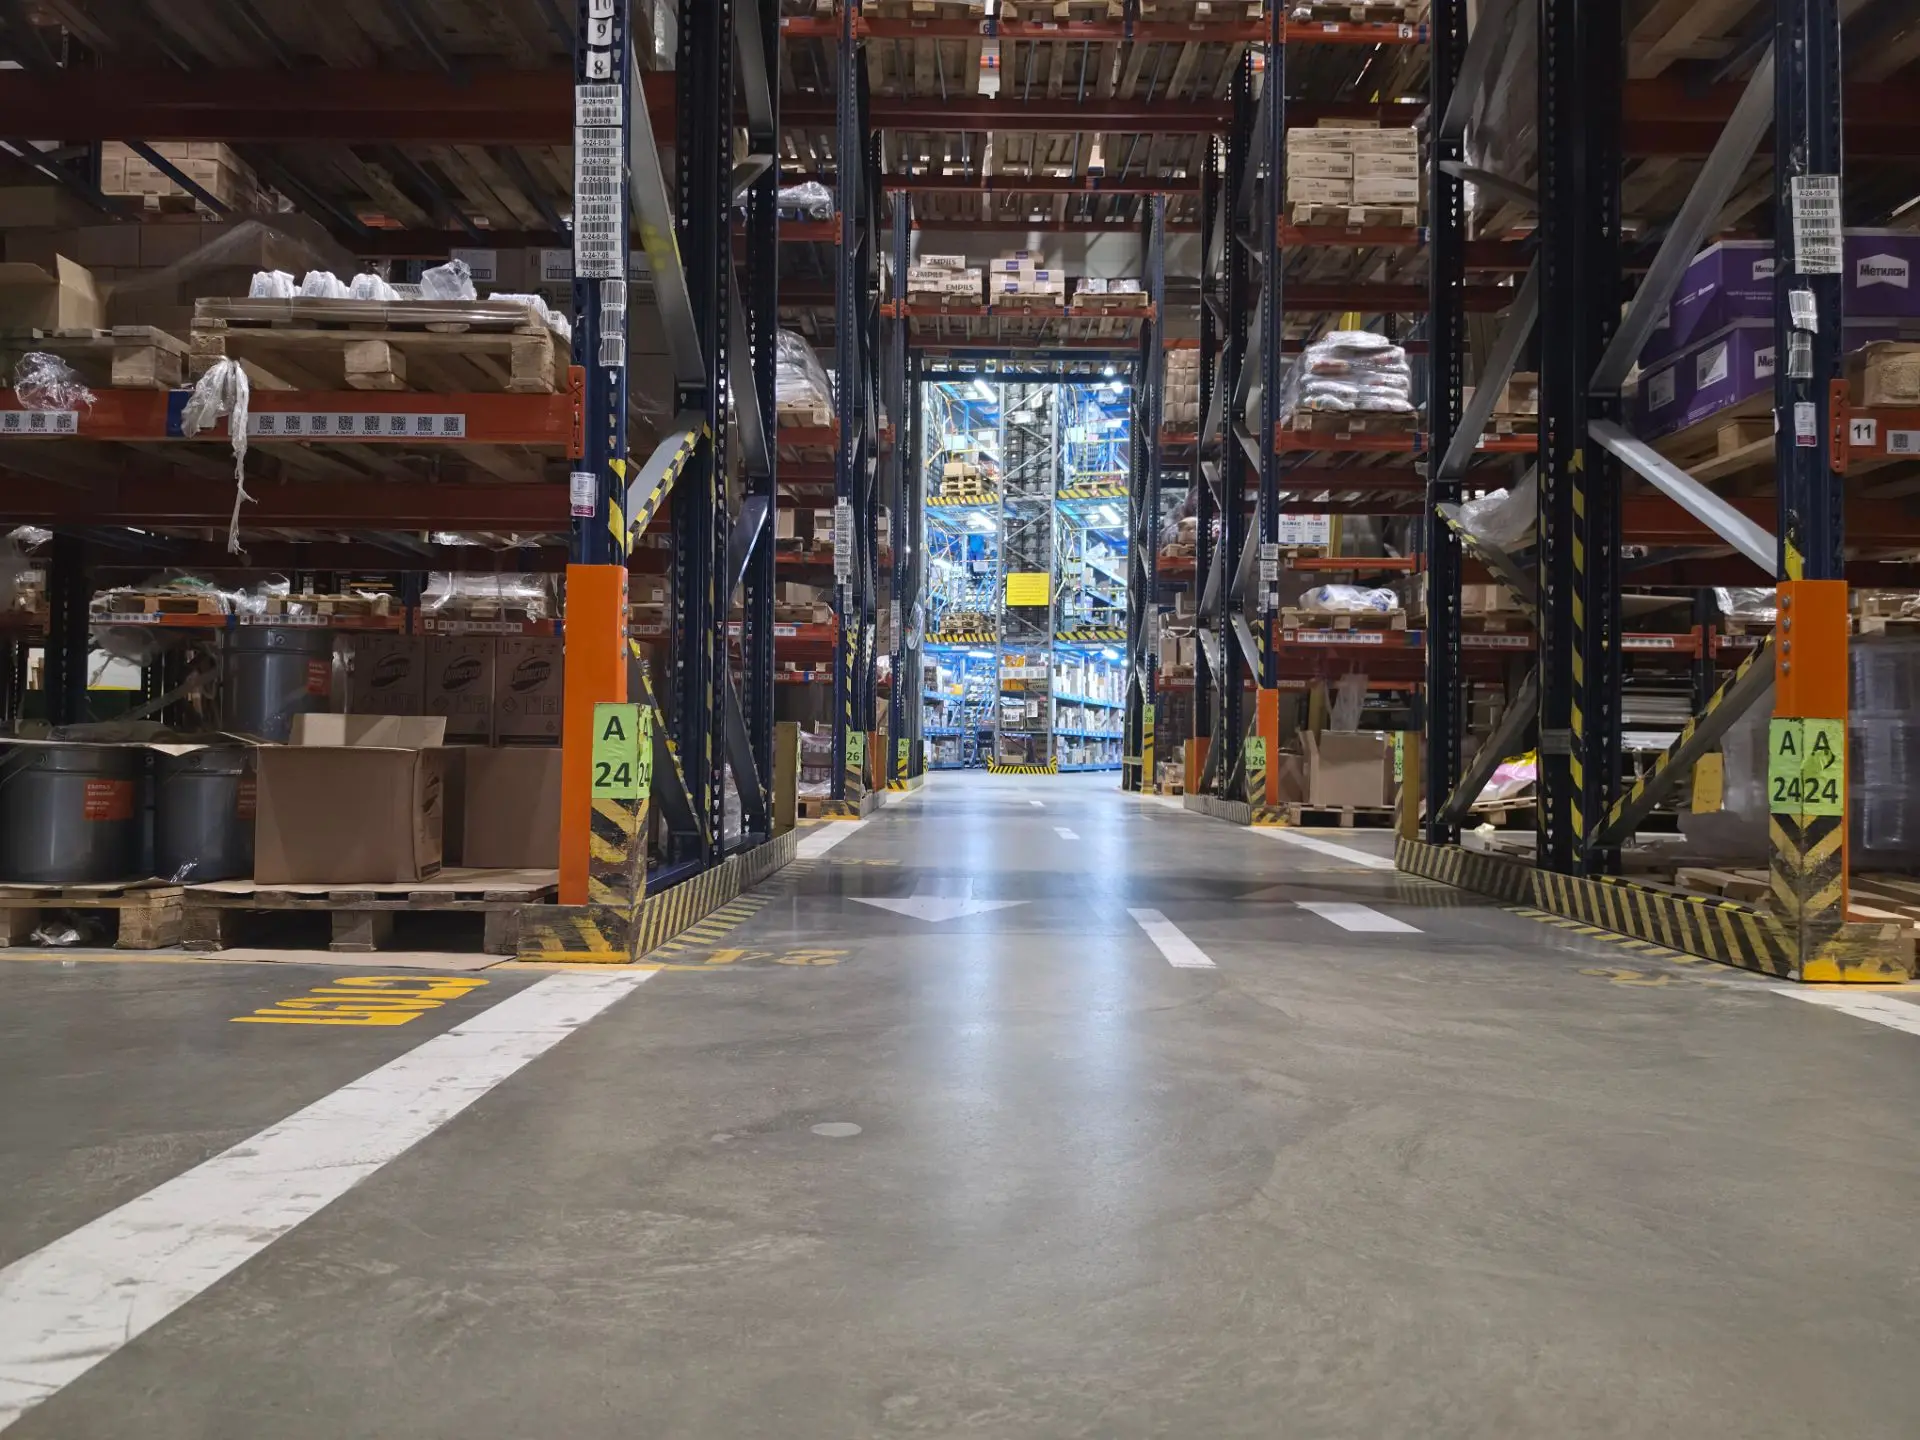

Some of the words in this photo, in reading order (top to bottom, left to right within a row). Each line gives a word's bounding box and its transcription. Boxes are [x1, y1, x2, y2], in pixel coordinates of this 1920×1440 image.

[597, 24, 607, 39] 9
[1401, 27, 1409, 38] 6
[594, 60, 604, 75] 8
[1860, 265, 1906, 277] Метилан
[945, 283, 974, 291] EMPILS
[1853, 424, 1871, 439] 11
[603, 715, 626, 741] A
[849, 736, 858, 745] A
[1255, 740, 1263, 749] A
[1779, 730, 1797, 756] A
[1811, 730, 1832, 756] A
[846, 751, 860, 761] 26
[1252, 755, 1266, 766] 26
[595, 762, 633, 788] 24
[1773, 776, 1802, 803] 24
[1804, 777, 1839, 804] 24
